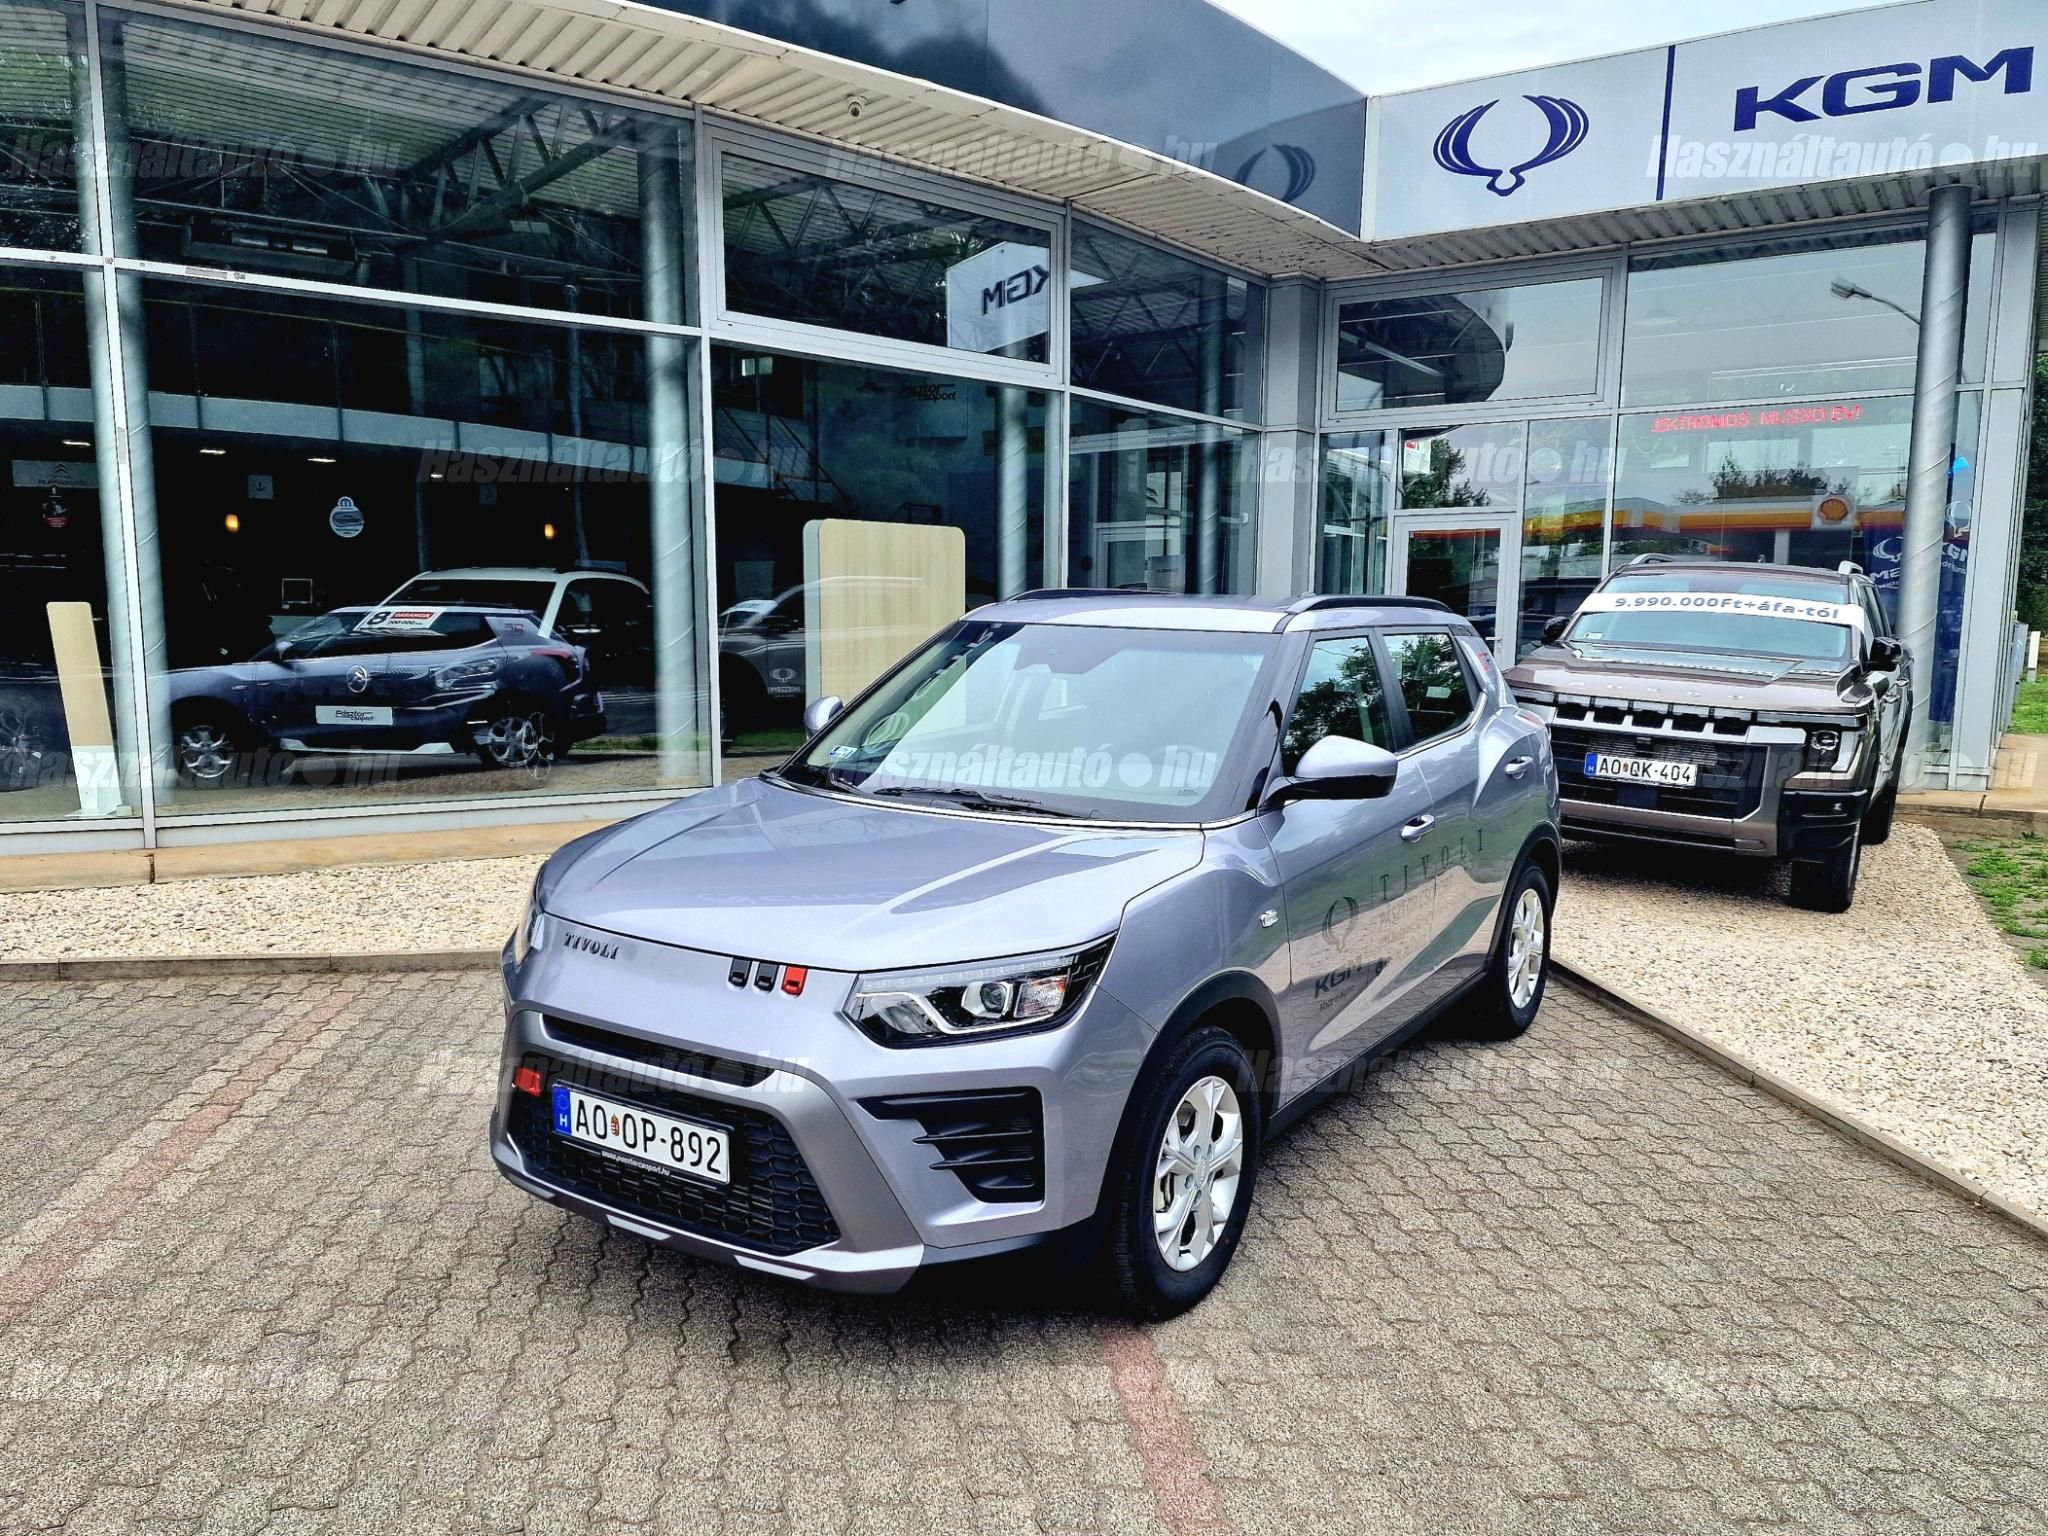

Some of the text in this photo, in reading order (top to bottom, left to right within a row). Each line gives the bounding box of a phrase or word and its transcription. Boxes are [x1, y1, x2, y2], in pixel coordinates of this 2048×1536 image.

[1733, 46, 2034, 132] KGM
[367, 611, 391, 625] 8
[1615, 596, 1839, 619] 9.990.000Ft+áfa-tól
[1630, 761, 1691, 782] QK-404
[563, 932, 620, 960] TIVOLI
[559, 1099, 722, 1175] H AO OP-892
